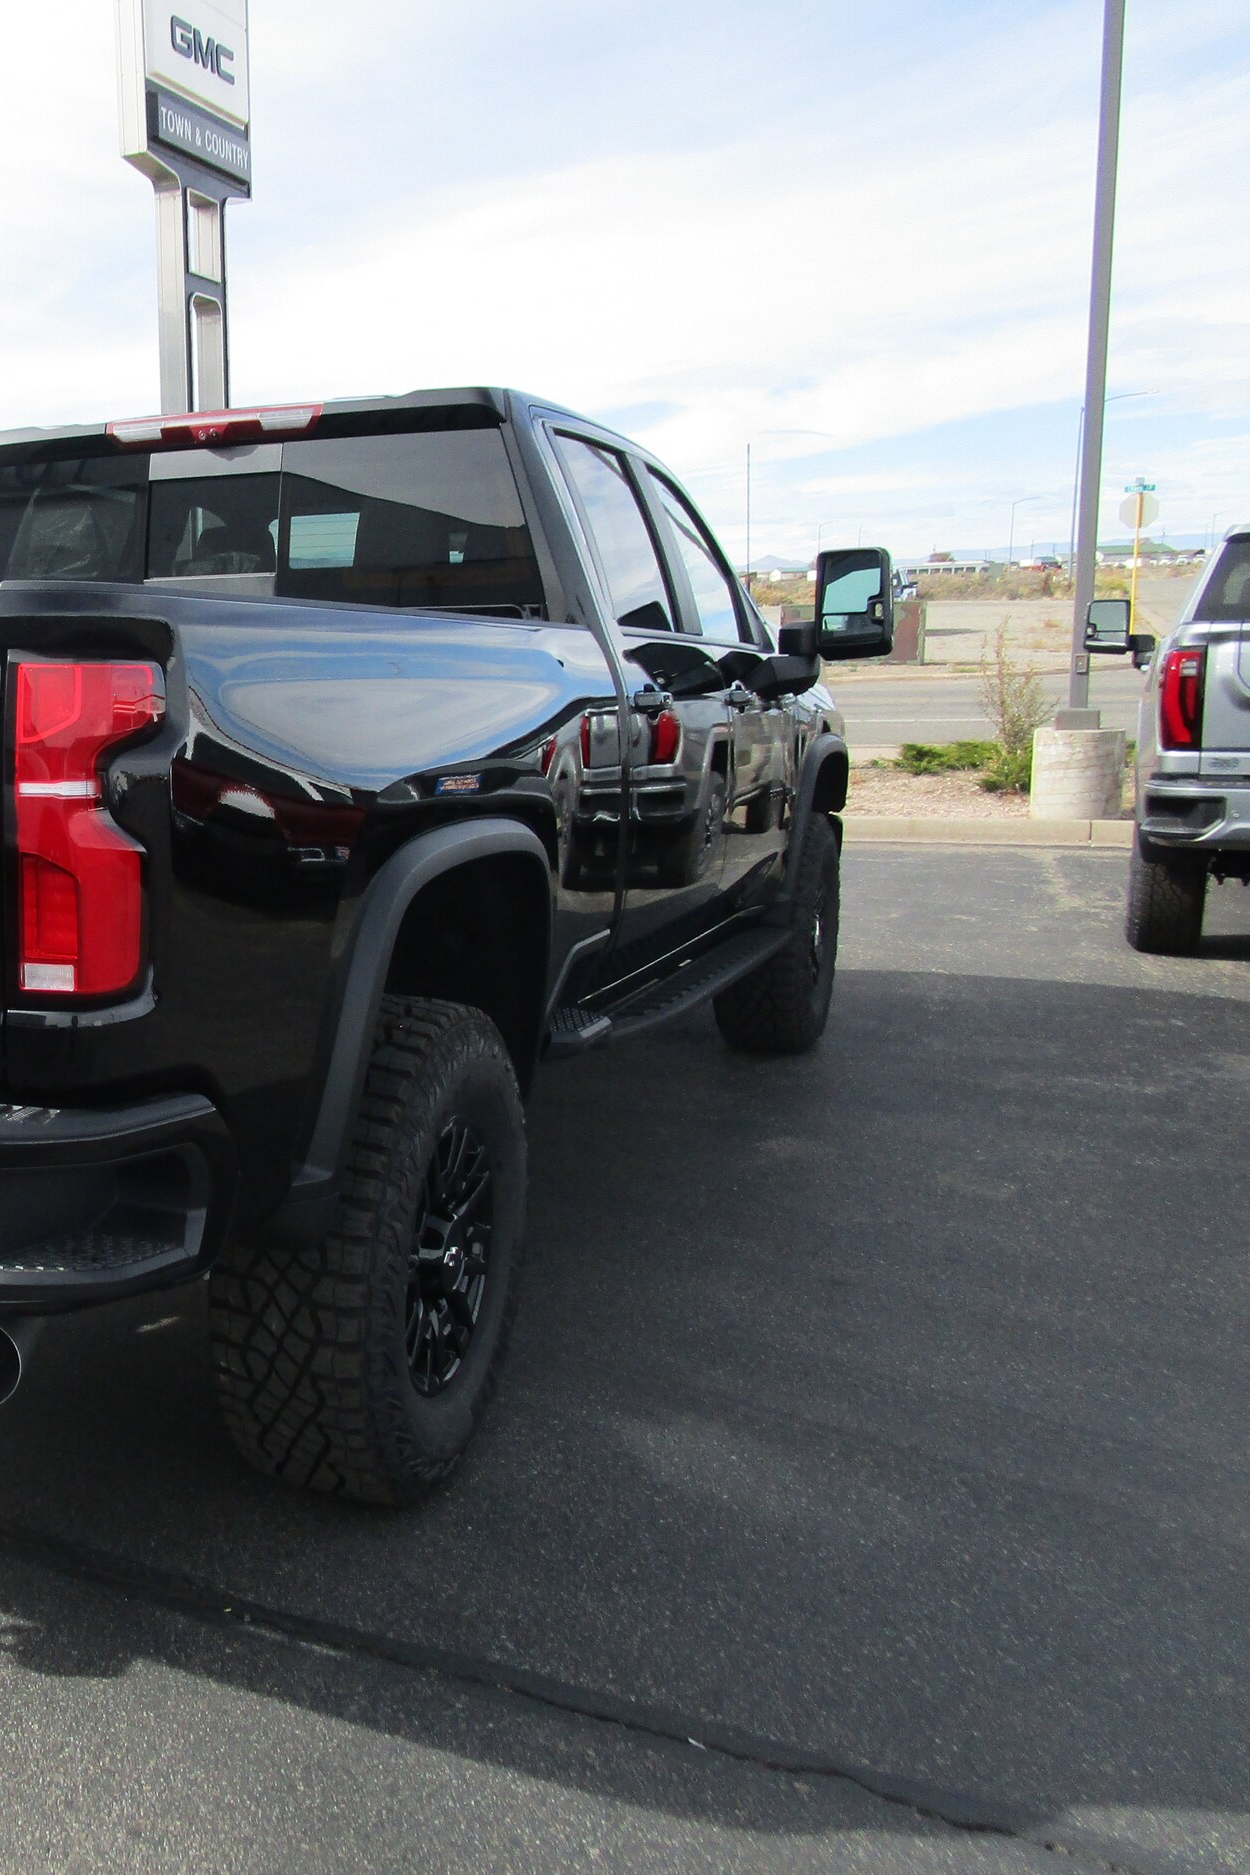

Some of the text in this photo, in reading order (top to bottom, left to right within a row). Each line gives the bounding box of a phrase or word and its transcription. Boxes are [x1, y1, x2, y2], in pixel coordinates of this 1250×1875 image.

[170, 14, 235, 86] GMC
[161, 106, 248, 170] TOWN & COUNTRY
